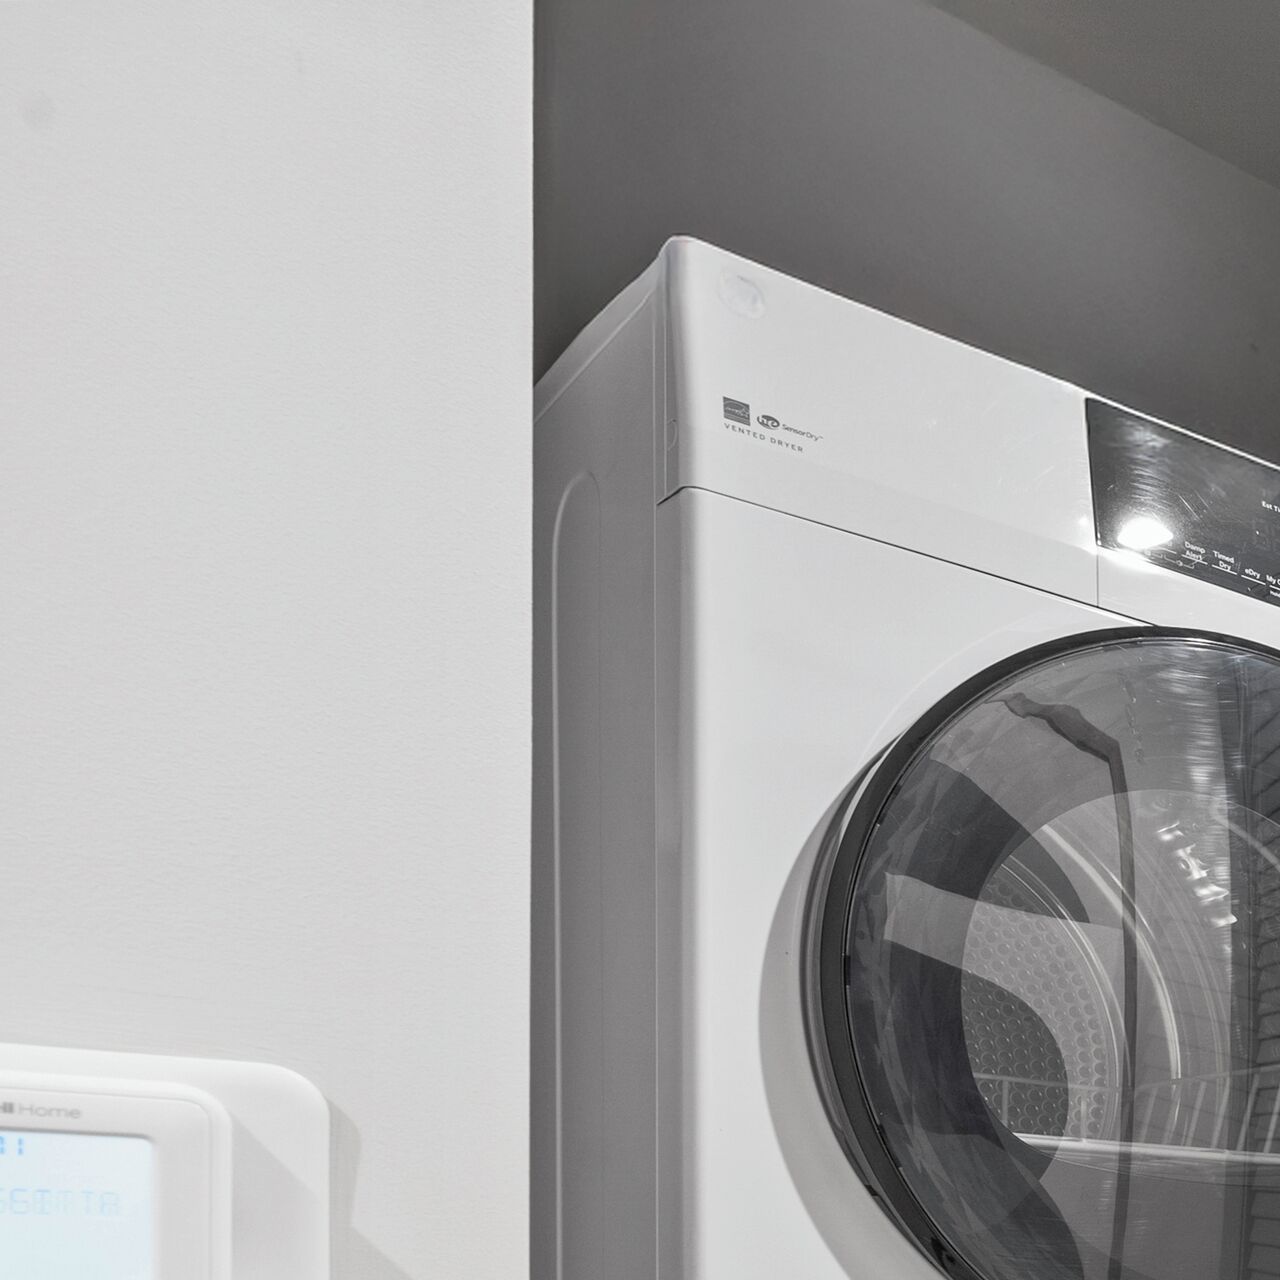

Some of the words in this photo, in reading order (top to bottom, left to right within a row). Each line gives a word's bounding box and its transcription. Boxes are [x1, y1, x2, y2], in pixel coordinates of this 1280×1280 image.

[724, 423, 765, 440] VENTED
[770, 437, 803, 452] DRYER
[1262, 501, 1272, 511] Est
[1185, 541, 1206, 555] Damp
[1212, 550, 1234, 563] Timed
[1218, 560, 1231, 572] Dry
[1266, 574, 1276, 584] My
[19, 1102, 81, 1119] Home
